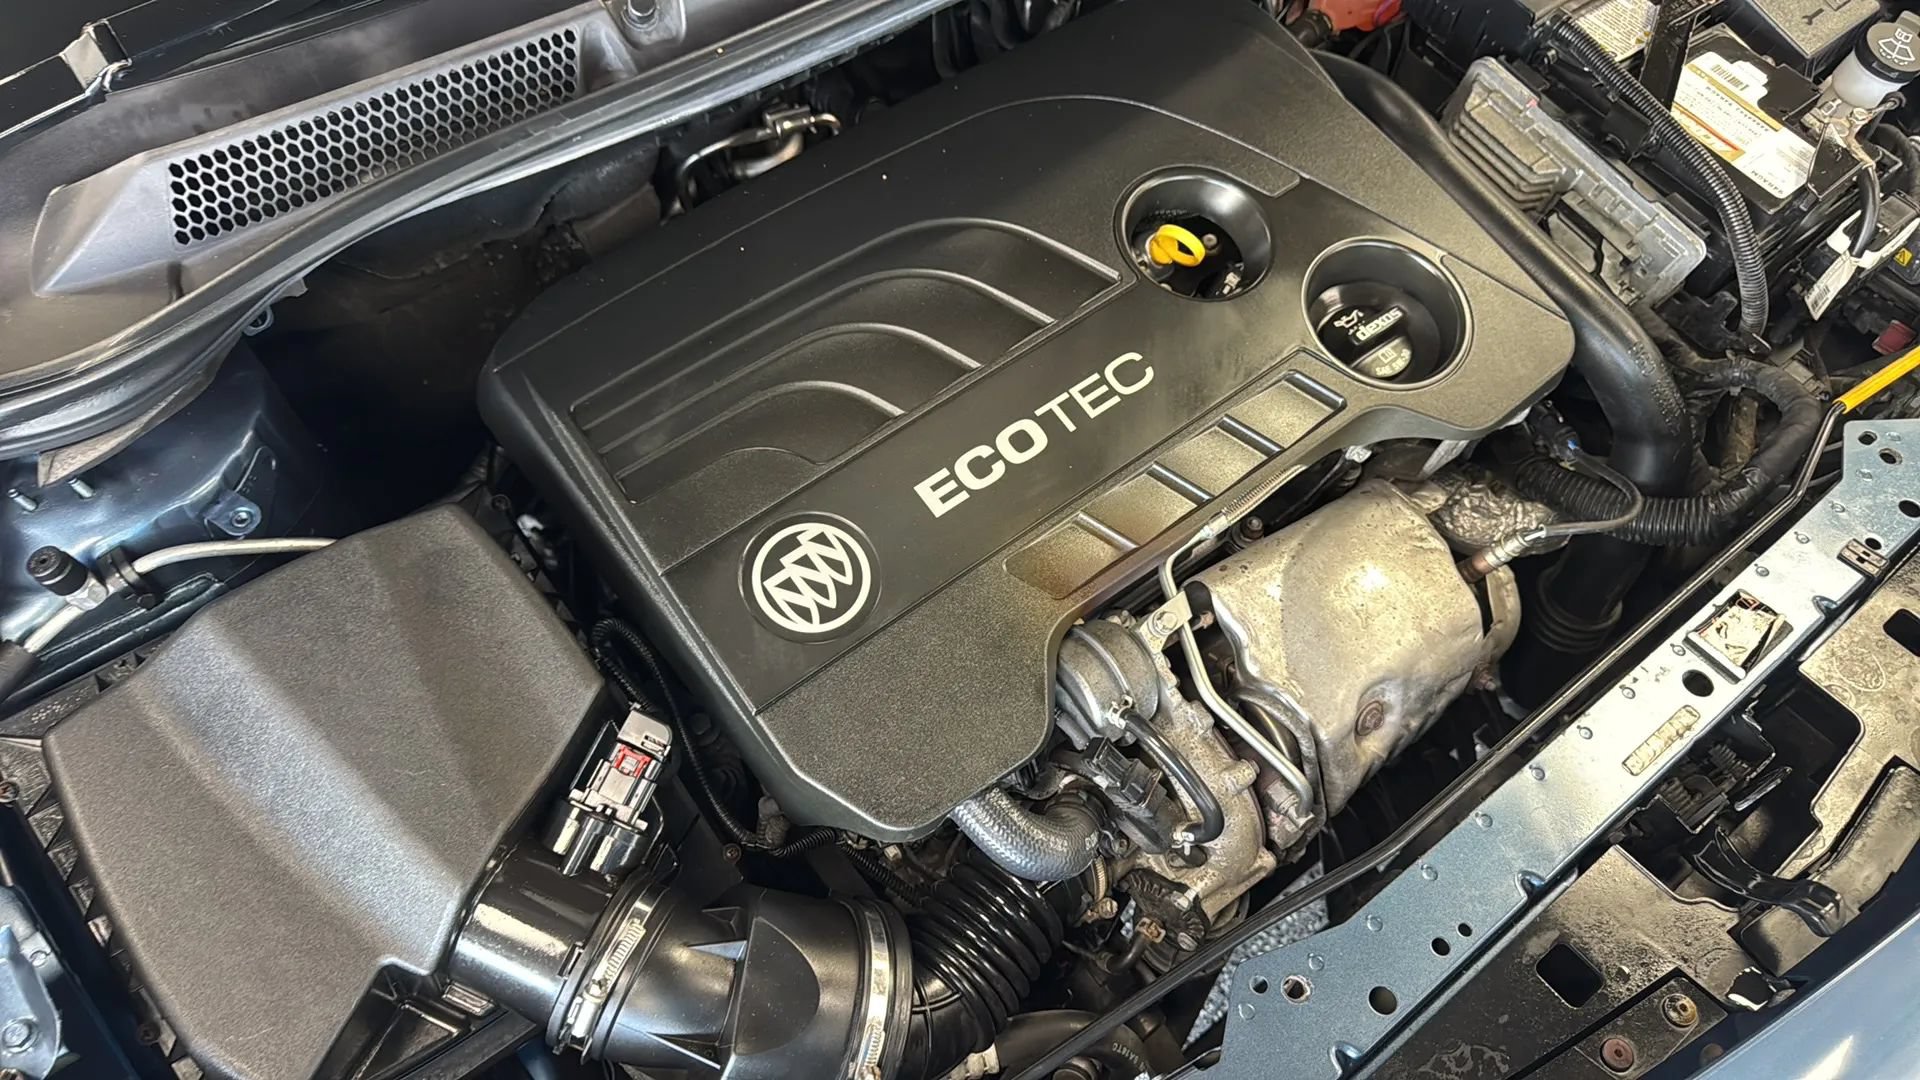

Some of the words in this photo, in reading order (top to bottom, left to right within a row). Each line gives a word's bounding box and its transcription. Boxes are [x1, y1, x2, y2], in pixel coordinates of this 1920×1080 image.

[1355, 308, 1403, 340] dexos
[1375, 364, 1391, 376] SAE
[913, 352, 1155, 518] ECOTEC
